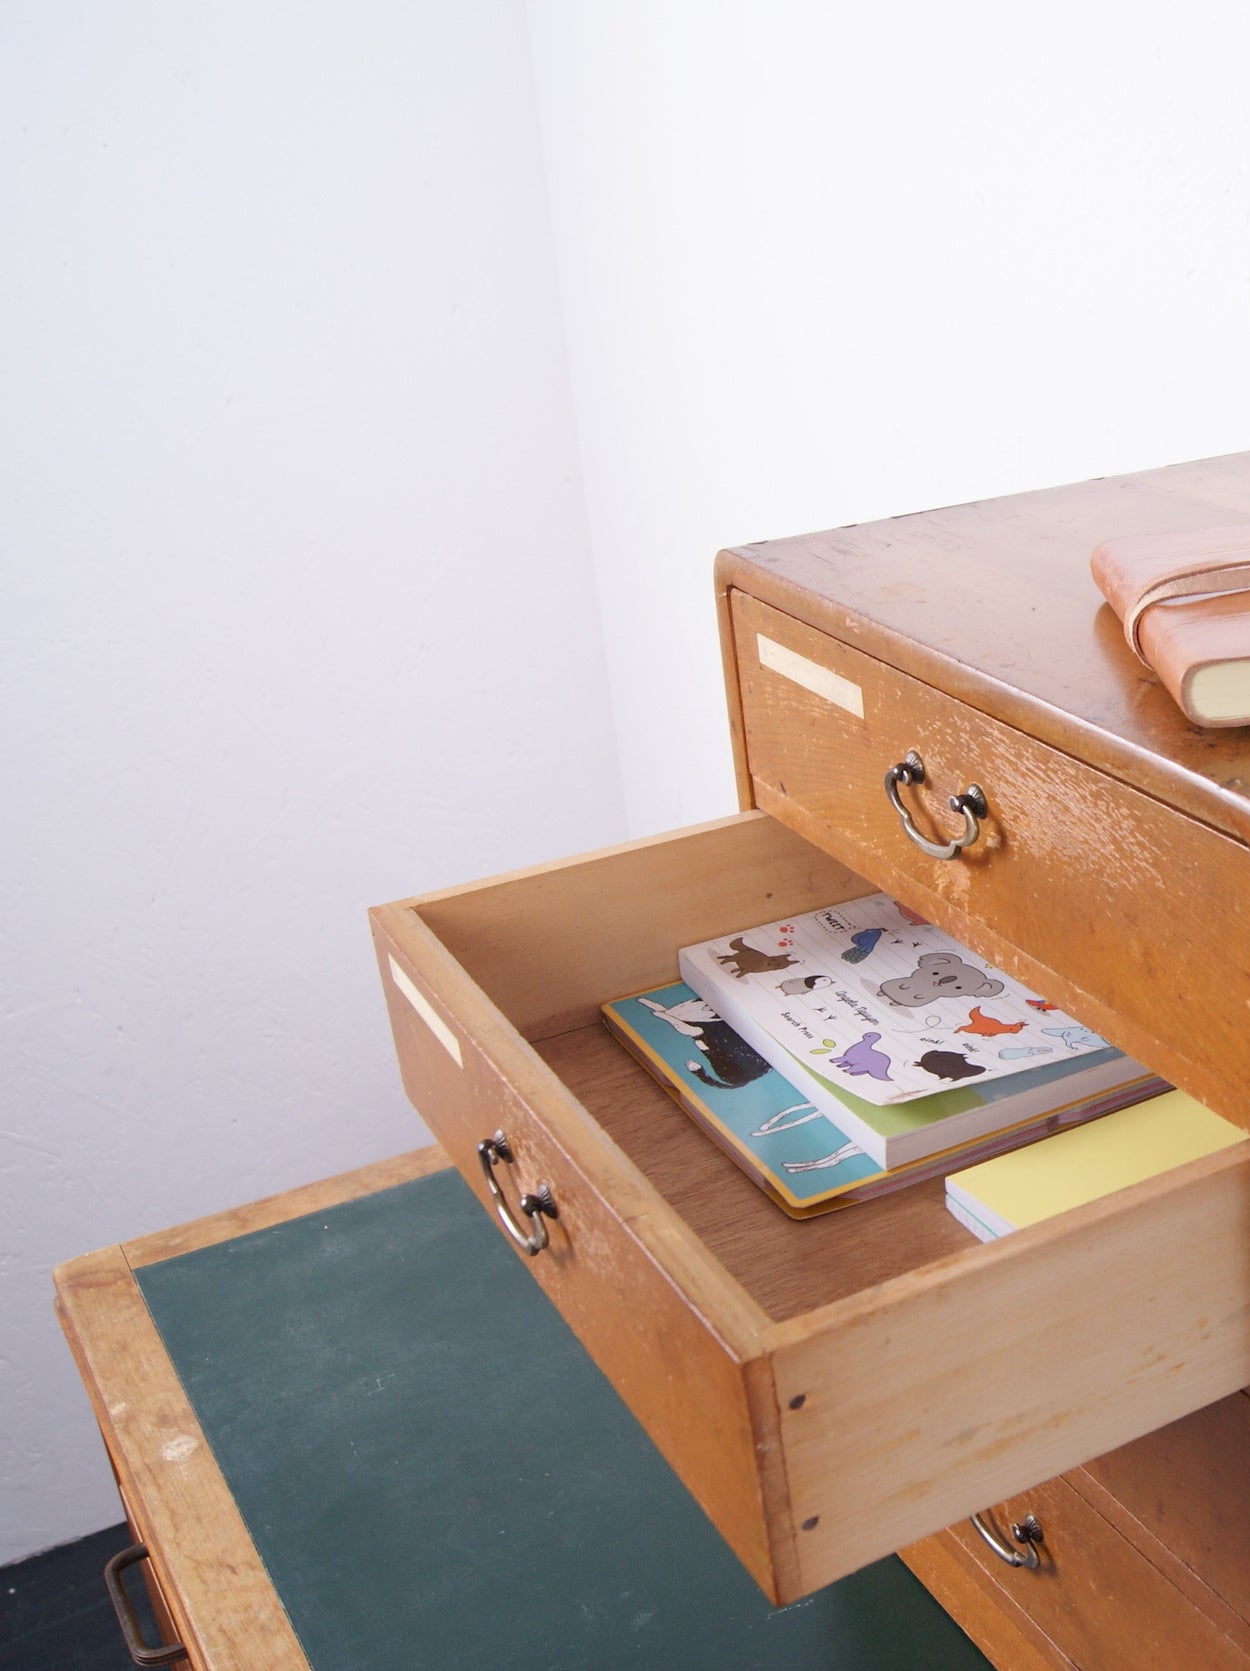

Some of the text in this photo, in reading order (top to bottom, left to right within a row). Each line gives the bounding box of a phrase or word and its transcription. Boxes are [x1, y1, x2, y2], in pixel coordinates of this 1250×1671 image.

[821, 912, 845, 930] TWEET
[835, 990, 859, 1009] Angela
[781, 1011, 814, 1039] Search Press
[919, 1037, 945, 1046] oink!
